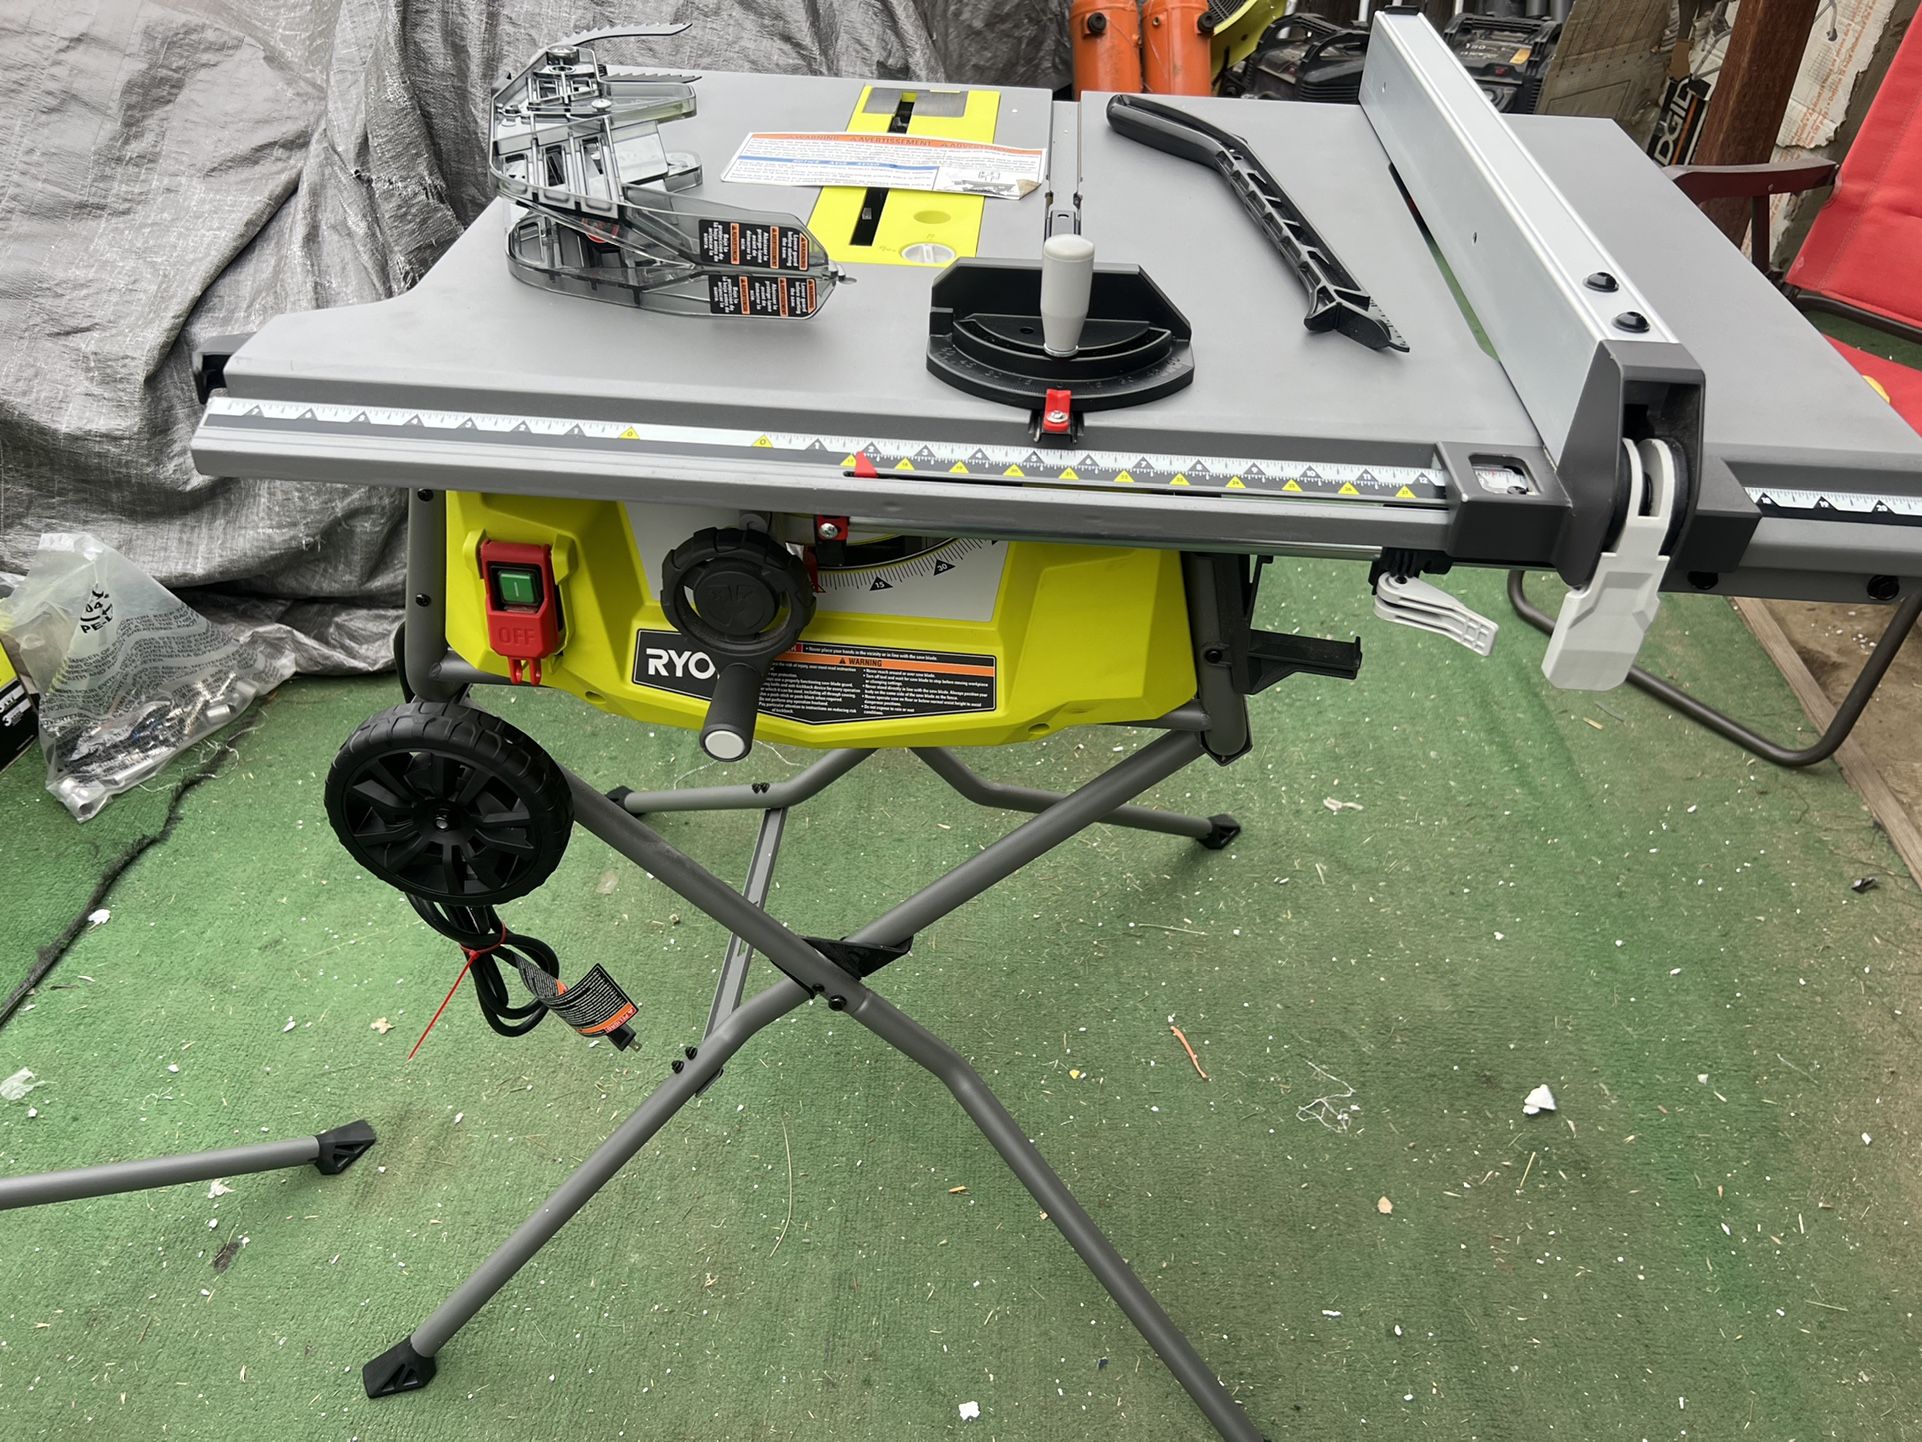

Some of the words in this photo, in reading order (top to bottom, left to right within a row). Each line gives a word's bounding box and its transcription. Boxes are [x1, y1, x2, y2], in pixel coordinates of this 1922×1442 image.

[1876, 504, 1888, 512] 20
[498, 627, 536, 645] OFF
[646, 648, 717, 680] RYO
[849, 658, 882, 666] WARNING
